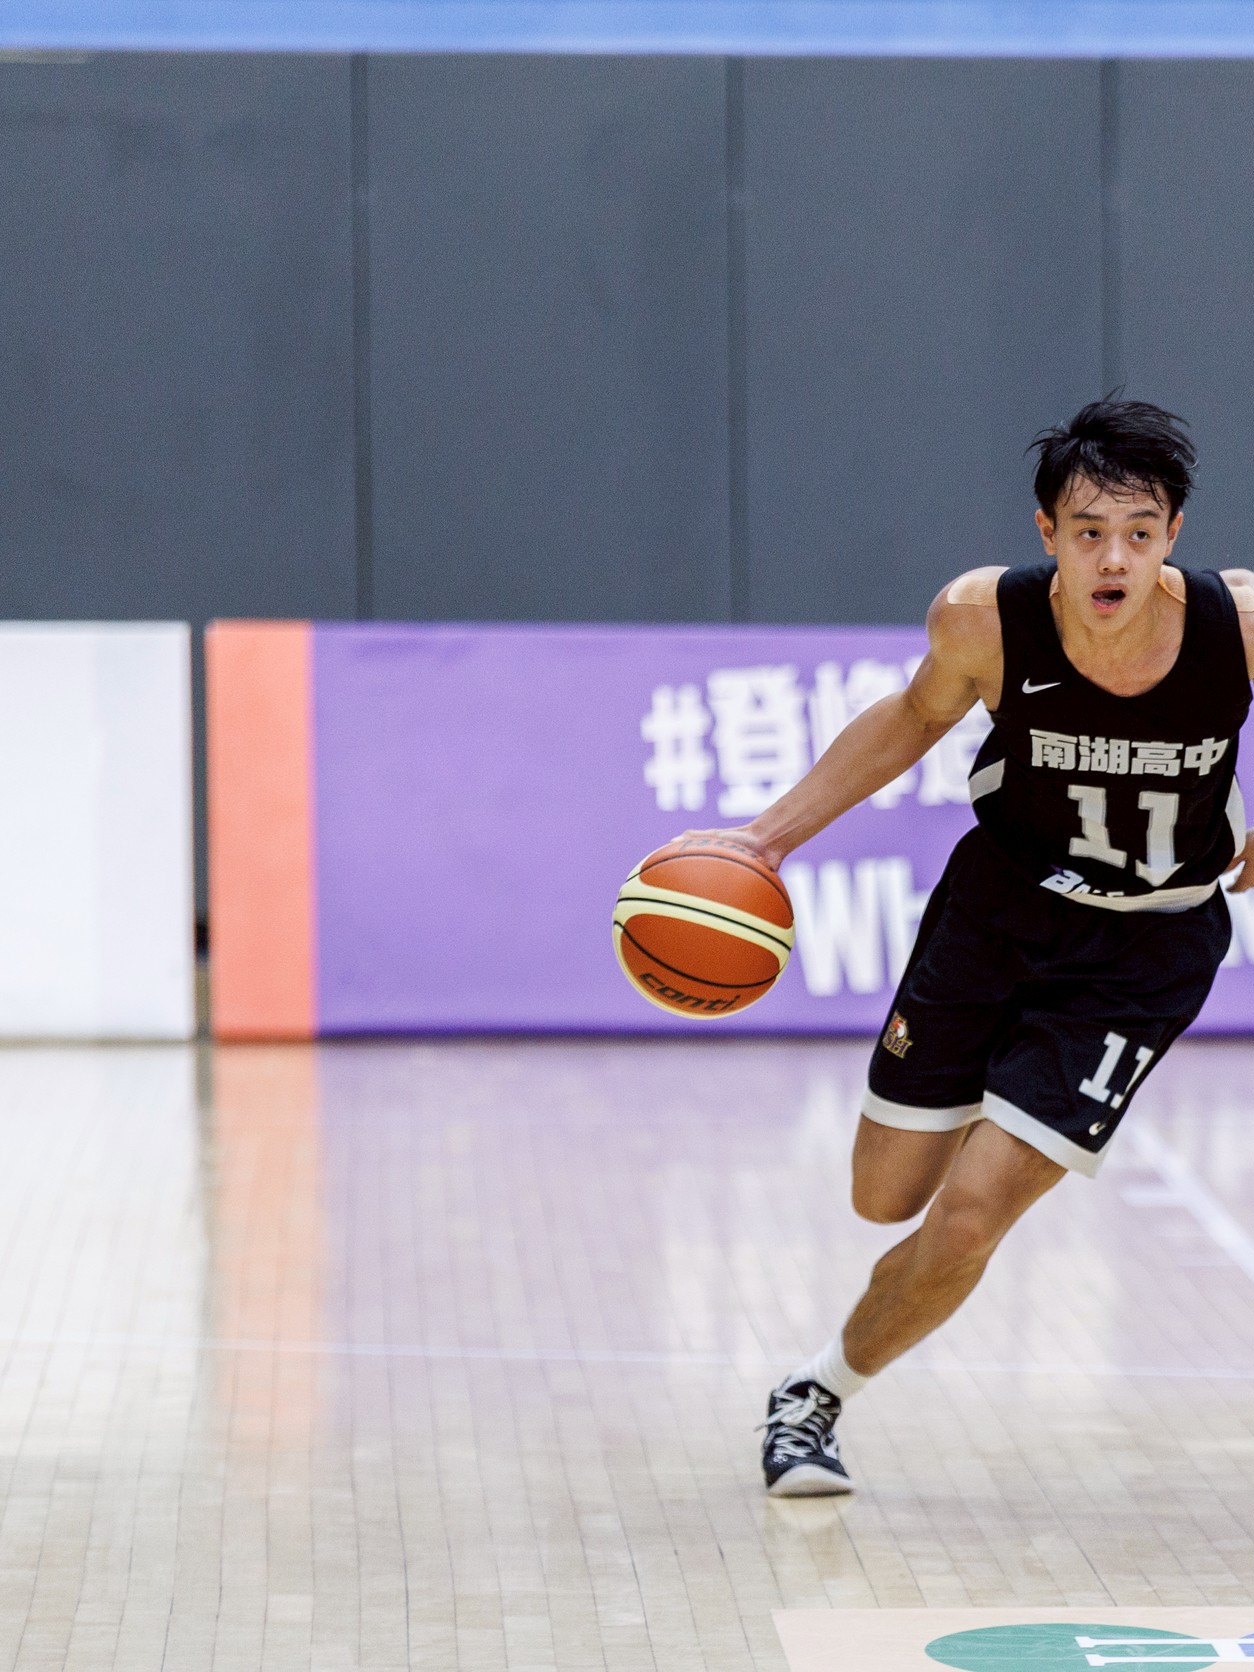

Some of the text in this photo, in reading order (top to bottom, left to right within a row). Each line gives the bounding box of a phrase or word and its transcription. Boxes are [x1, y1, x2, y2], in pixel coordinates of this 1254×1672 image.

[1029, 728, 1229, 777] 南湖高中
[1067, 784, 1180, 887] 11
